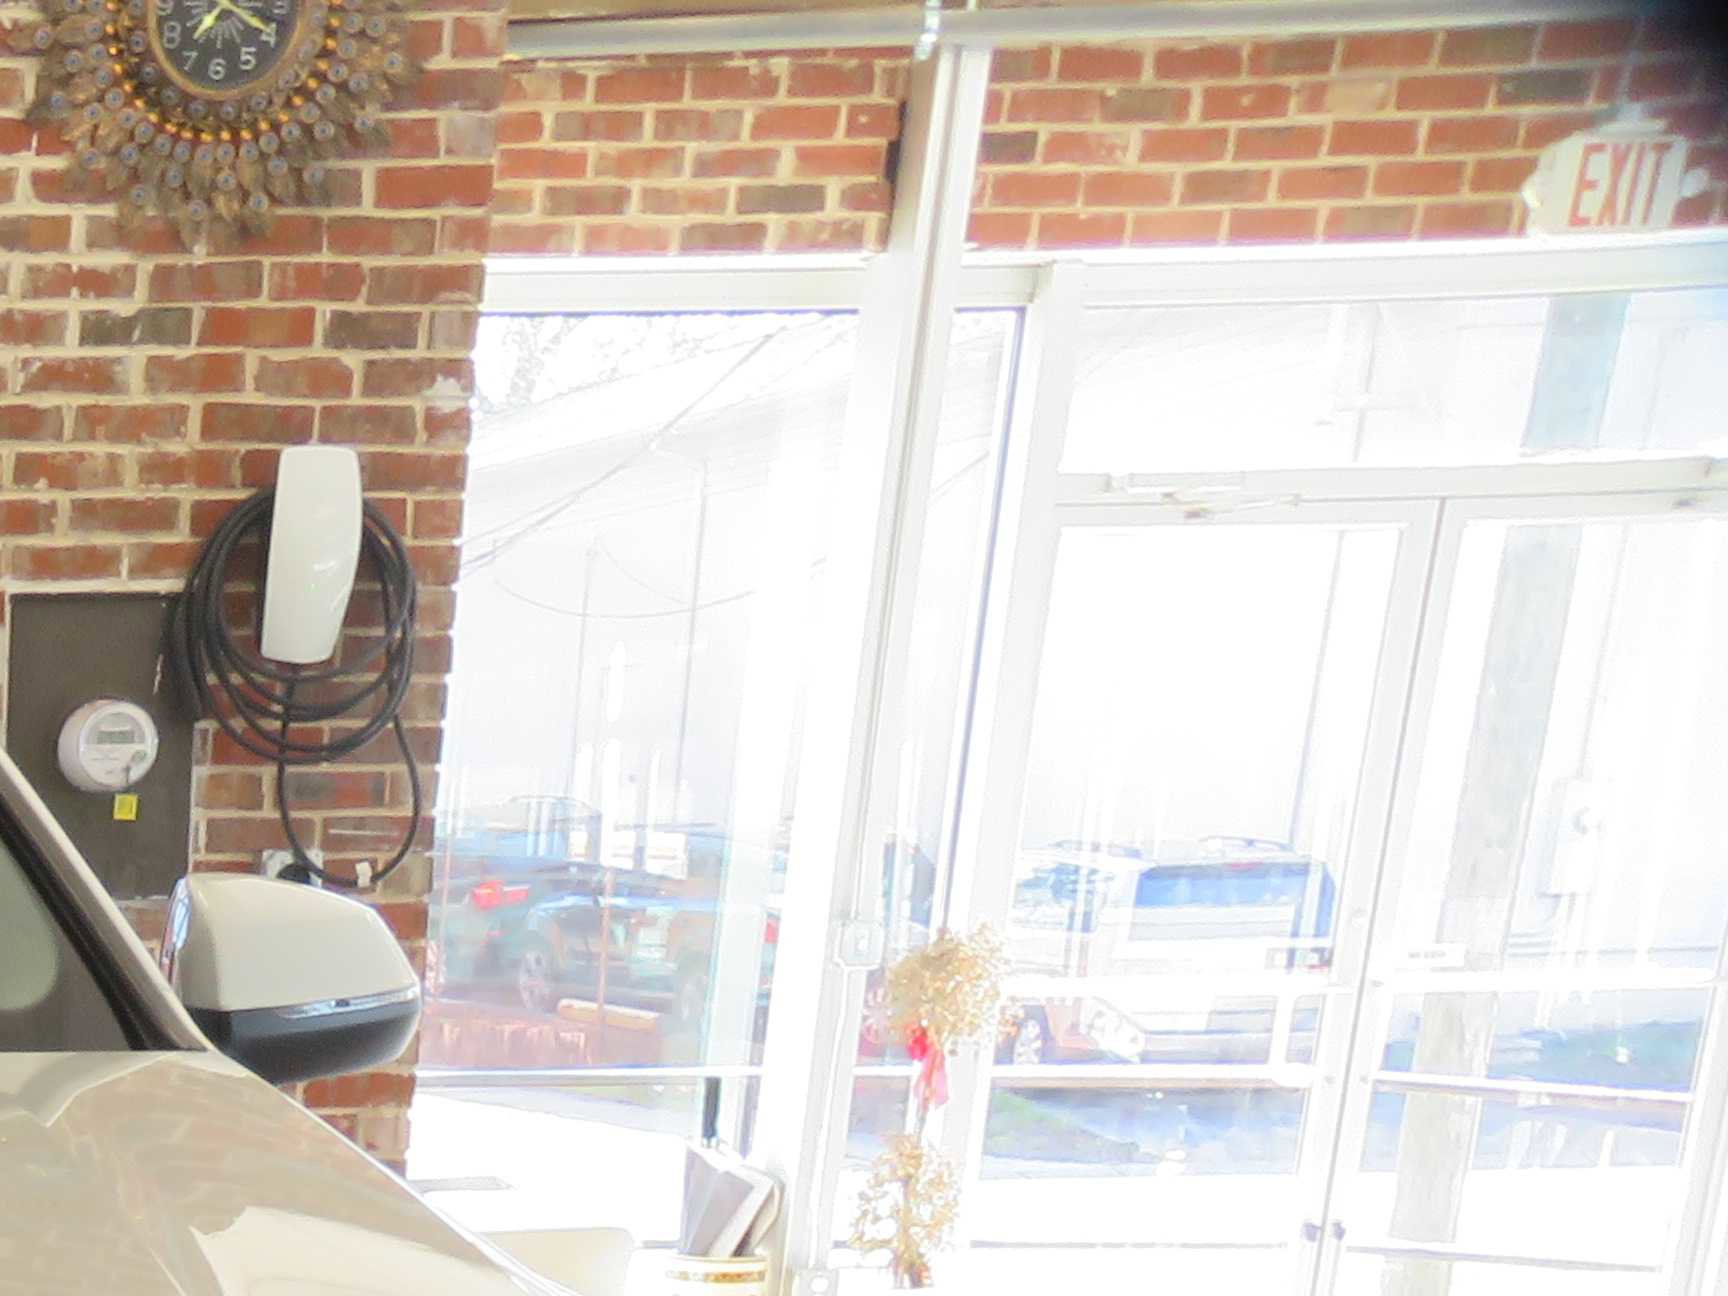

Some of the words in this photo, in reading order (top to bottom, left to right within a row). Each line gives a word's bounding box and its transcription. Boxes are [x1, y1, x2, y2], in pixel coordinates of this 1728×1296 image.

[163, 21, 181, 49] 8
[260, 22, 277, 48] 4
[182, 50, 198, 71] 7
[208, 58, 227, 81] 6
[239, 47, 257, 70] 5
[1568, 142, 1673, 227] EXIT
